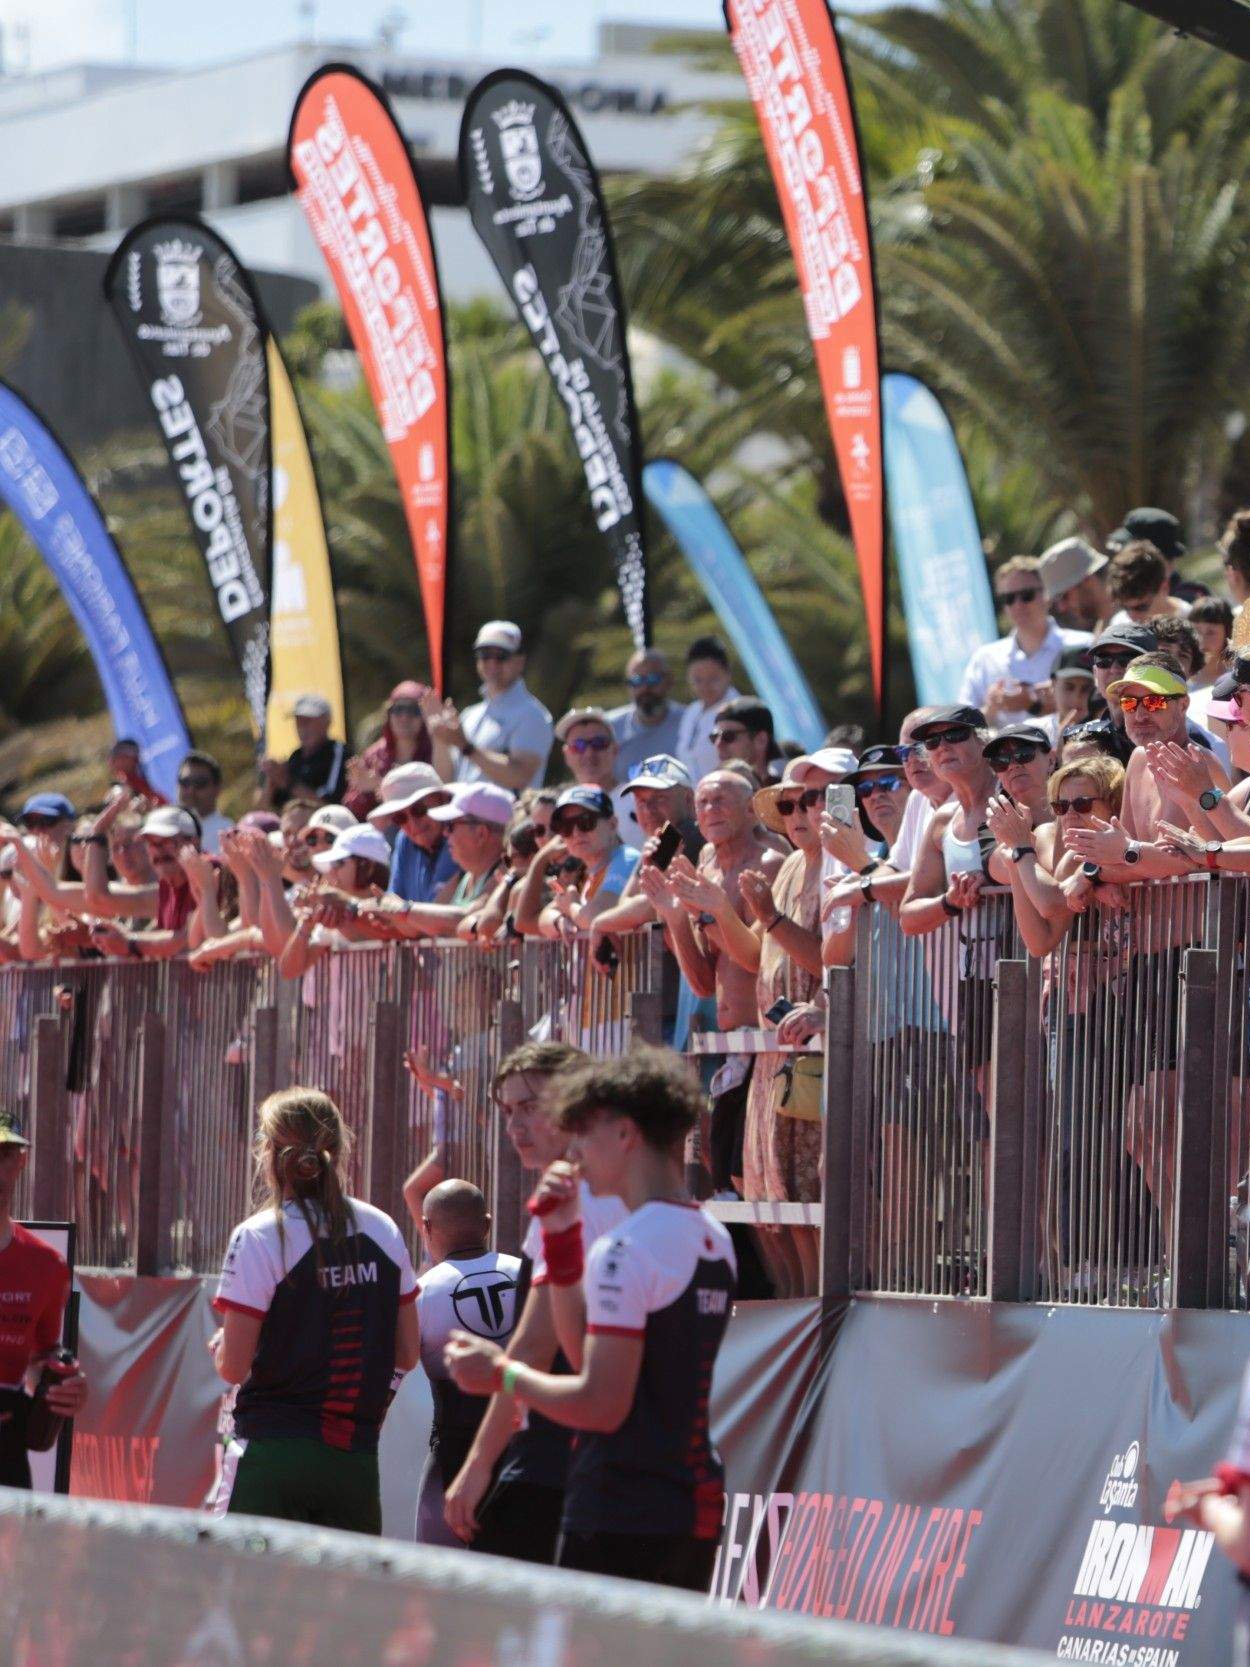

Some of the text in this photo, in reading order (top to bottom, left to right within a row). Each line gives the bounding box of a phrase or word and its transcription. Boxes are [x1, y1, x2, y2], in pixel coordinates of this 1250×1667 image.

[318, 1261, 378, 1288] TEAM
[697, 1288, 728, 1315] TEAM
[892, 1507, 984, 1637] FIRE
[1073, 1519, 1216, 1609] IRONMAN
[1063, 1599, 1191, 1642] LANZAROTE
[1056, 1635, 1180, 1667] CANARIAS SPAIN
